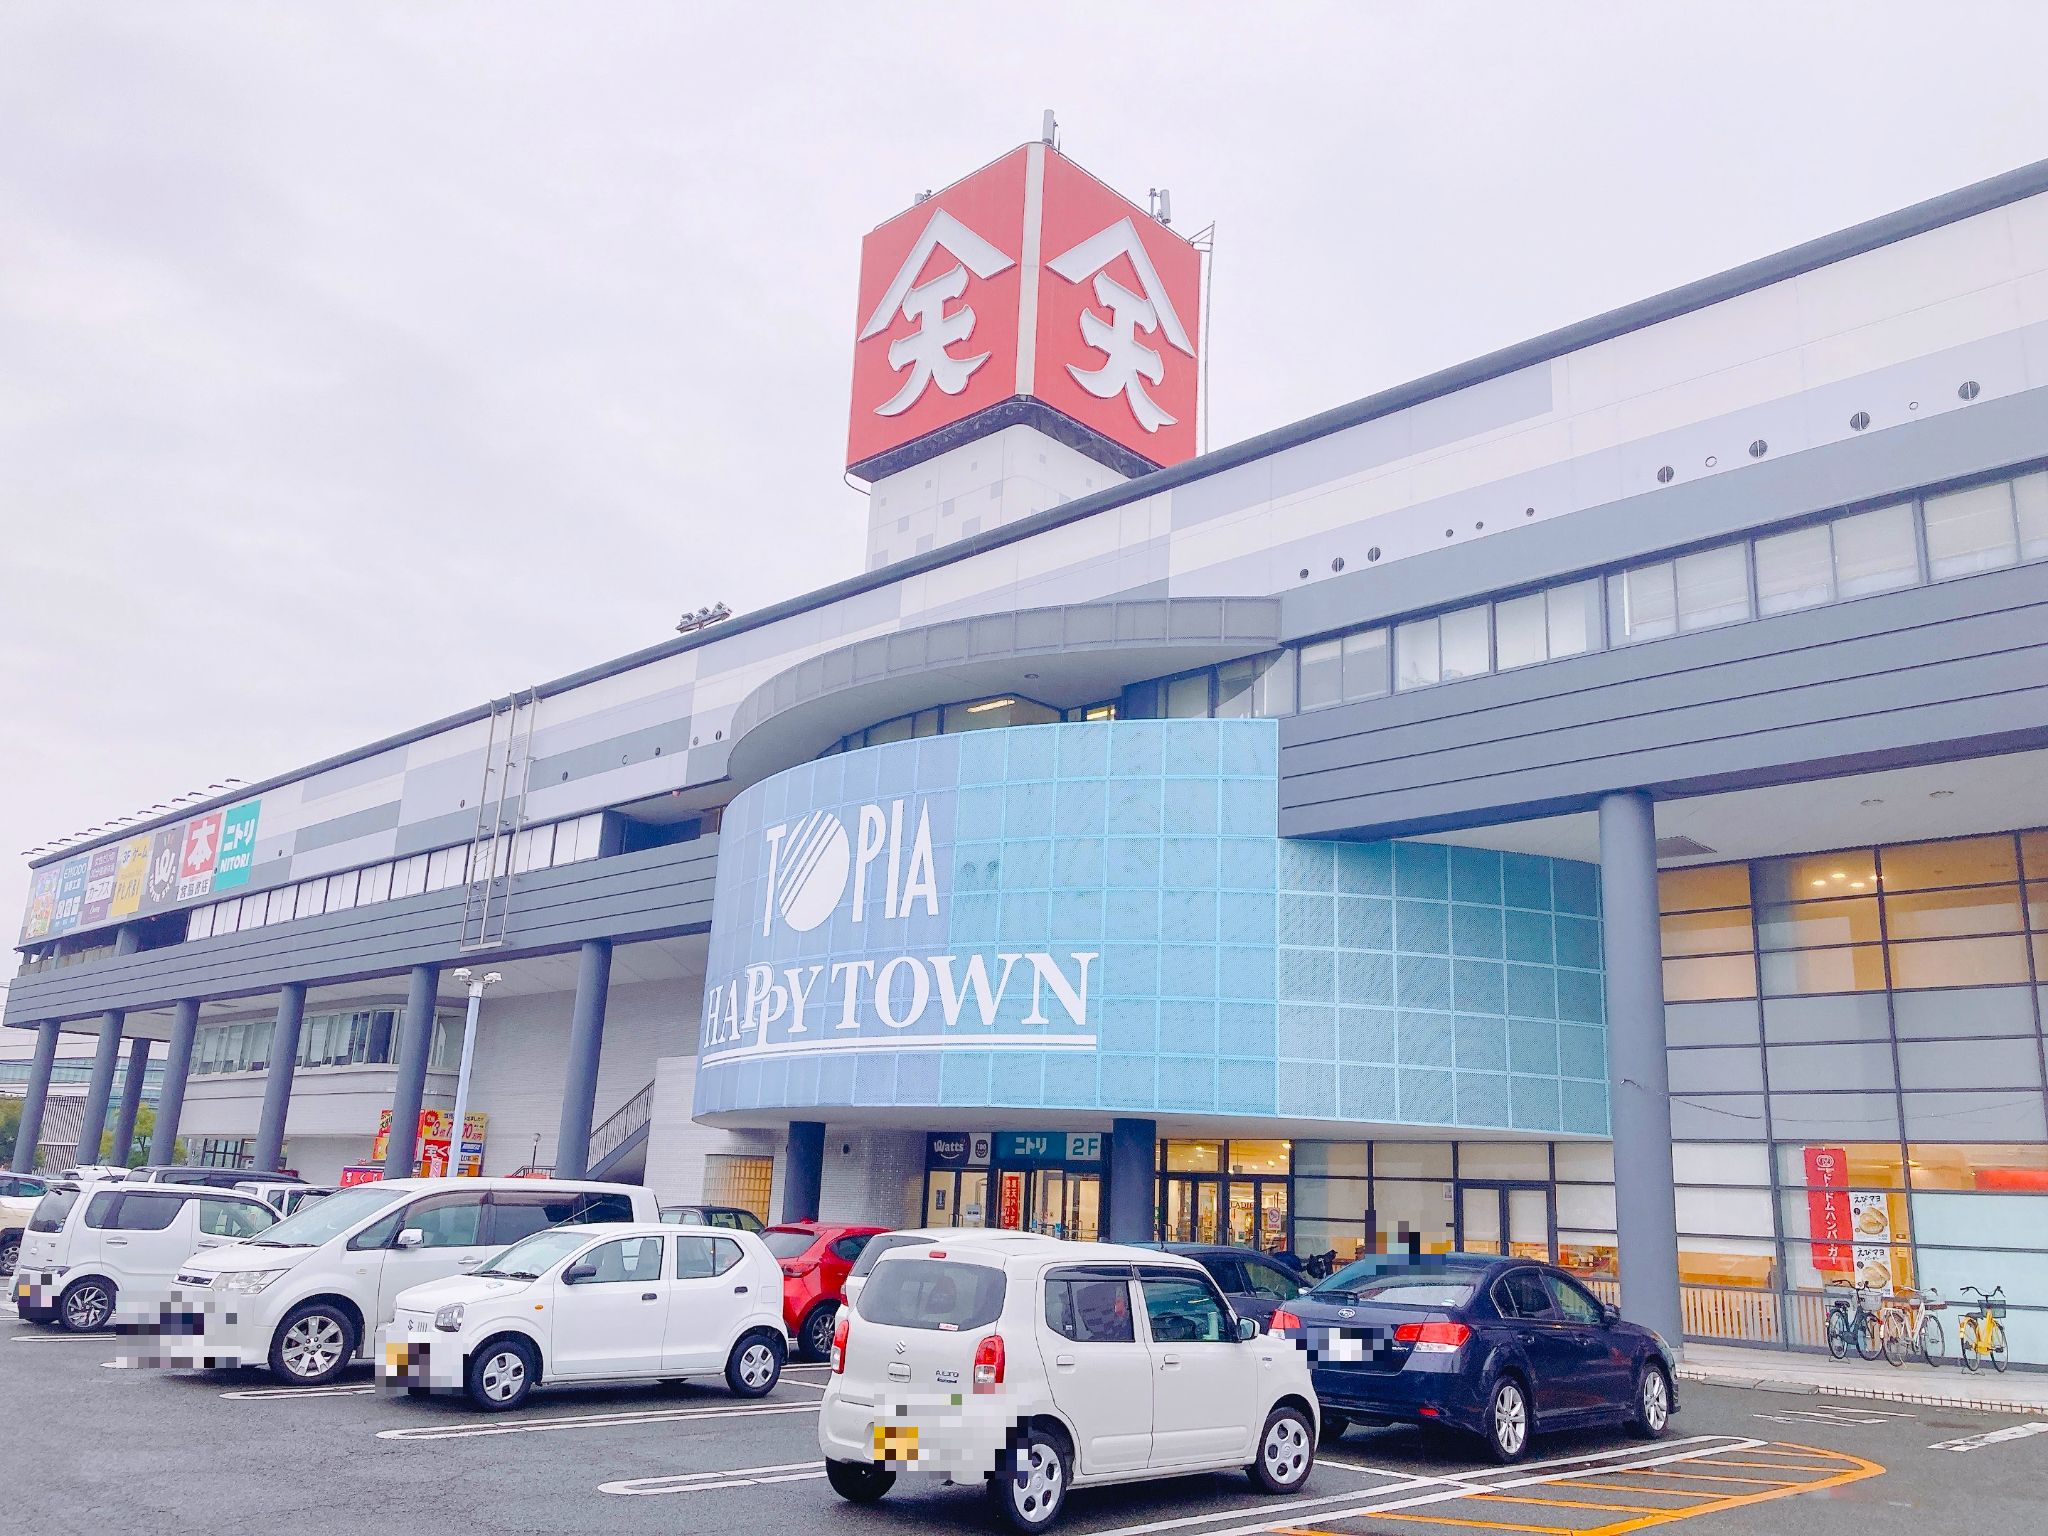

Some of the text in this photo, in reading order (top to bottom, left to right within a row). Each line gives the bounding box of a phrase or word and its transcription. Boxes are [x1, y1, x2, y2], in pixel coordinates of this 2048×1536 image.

[223, 818, 256, 852] ニトリ
[187, 819, 217, 871] 本
[219, 852, 251, 873] NITORI
[762, 797, 939, 937] TOPIA
[703, 952, 1100, 1048] HAPPY TOWN
[424, 1143, 451, 1161] 宝く
[934, 1139, 965, 1153] Watts
[1014, 1136, 1047, 1155] ニトリ
[1072, 1137, 1098, 1155] 2F
[1854, 1194, 1881, 1204] えびマヨ
[1857, 1247, 1885, 1258] えびマヨ
